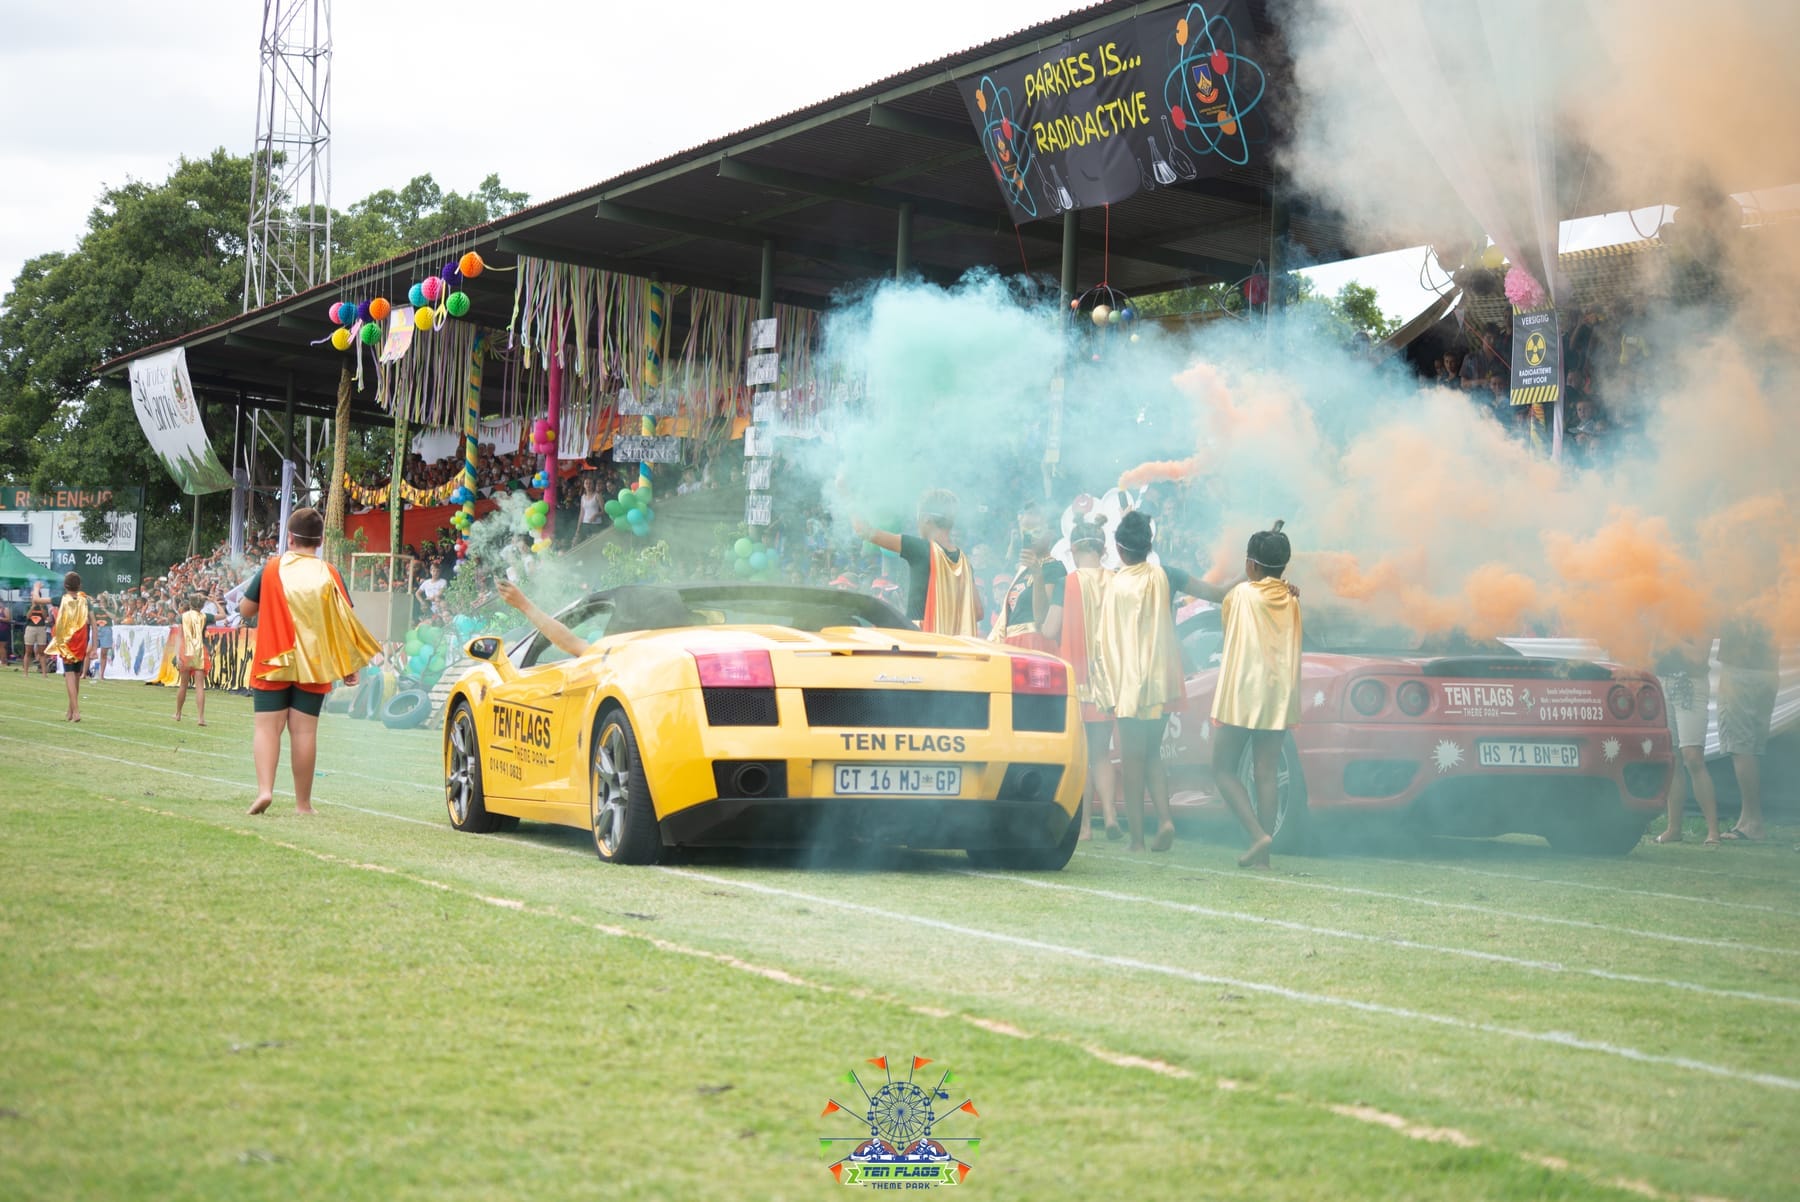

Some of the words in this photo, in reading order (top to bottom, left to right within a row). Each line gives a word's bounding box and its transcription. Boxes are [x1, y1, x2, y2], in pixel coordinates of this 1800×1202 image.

[1025, 52, 1096, 108] PARKIES
[1099, 42, 1141, 78] IS...
[1032, 91, 1150, 154] RADIOACTIVE
[85, 553, 104, 565] 2de
[116, 574, 132, 583] RHS
[1444, 687, 1470, 706] TEN
[1474, 687, 1514, 707] FLAGS
[1540, 706, 1558, 720] 014
[1560, 706, 1578, 720] 941
[1581, 706, 1603, 720] 0823
[493, 704, 512, 739] TEN
[514, 710, 551, 749] FLAGS
[840, 733, 886, 751] TEN
[895, 734, 966, 753] FLAGS
[1483, 745, 1500, 762] HS
[1509, 745, 1526, 763] 71
[1535, 744, 1551, 764] BN
[1561, 744, 1577, 765] GP
[840, 769, 861, 790] CT
[870, 770, 890, 790] 16
[900, 769, 920, 791] MJ
[936, 770, 956, 791] GP
